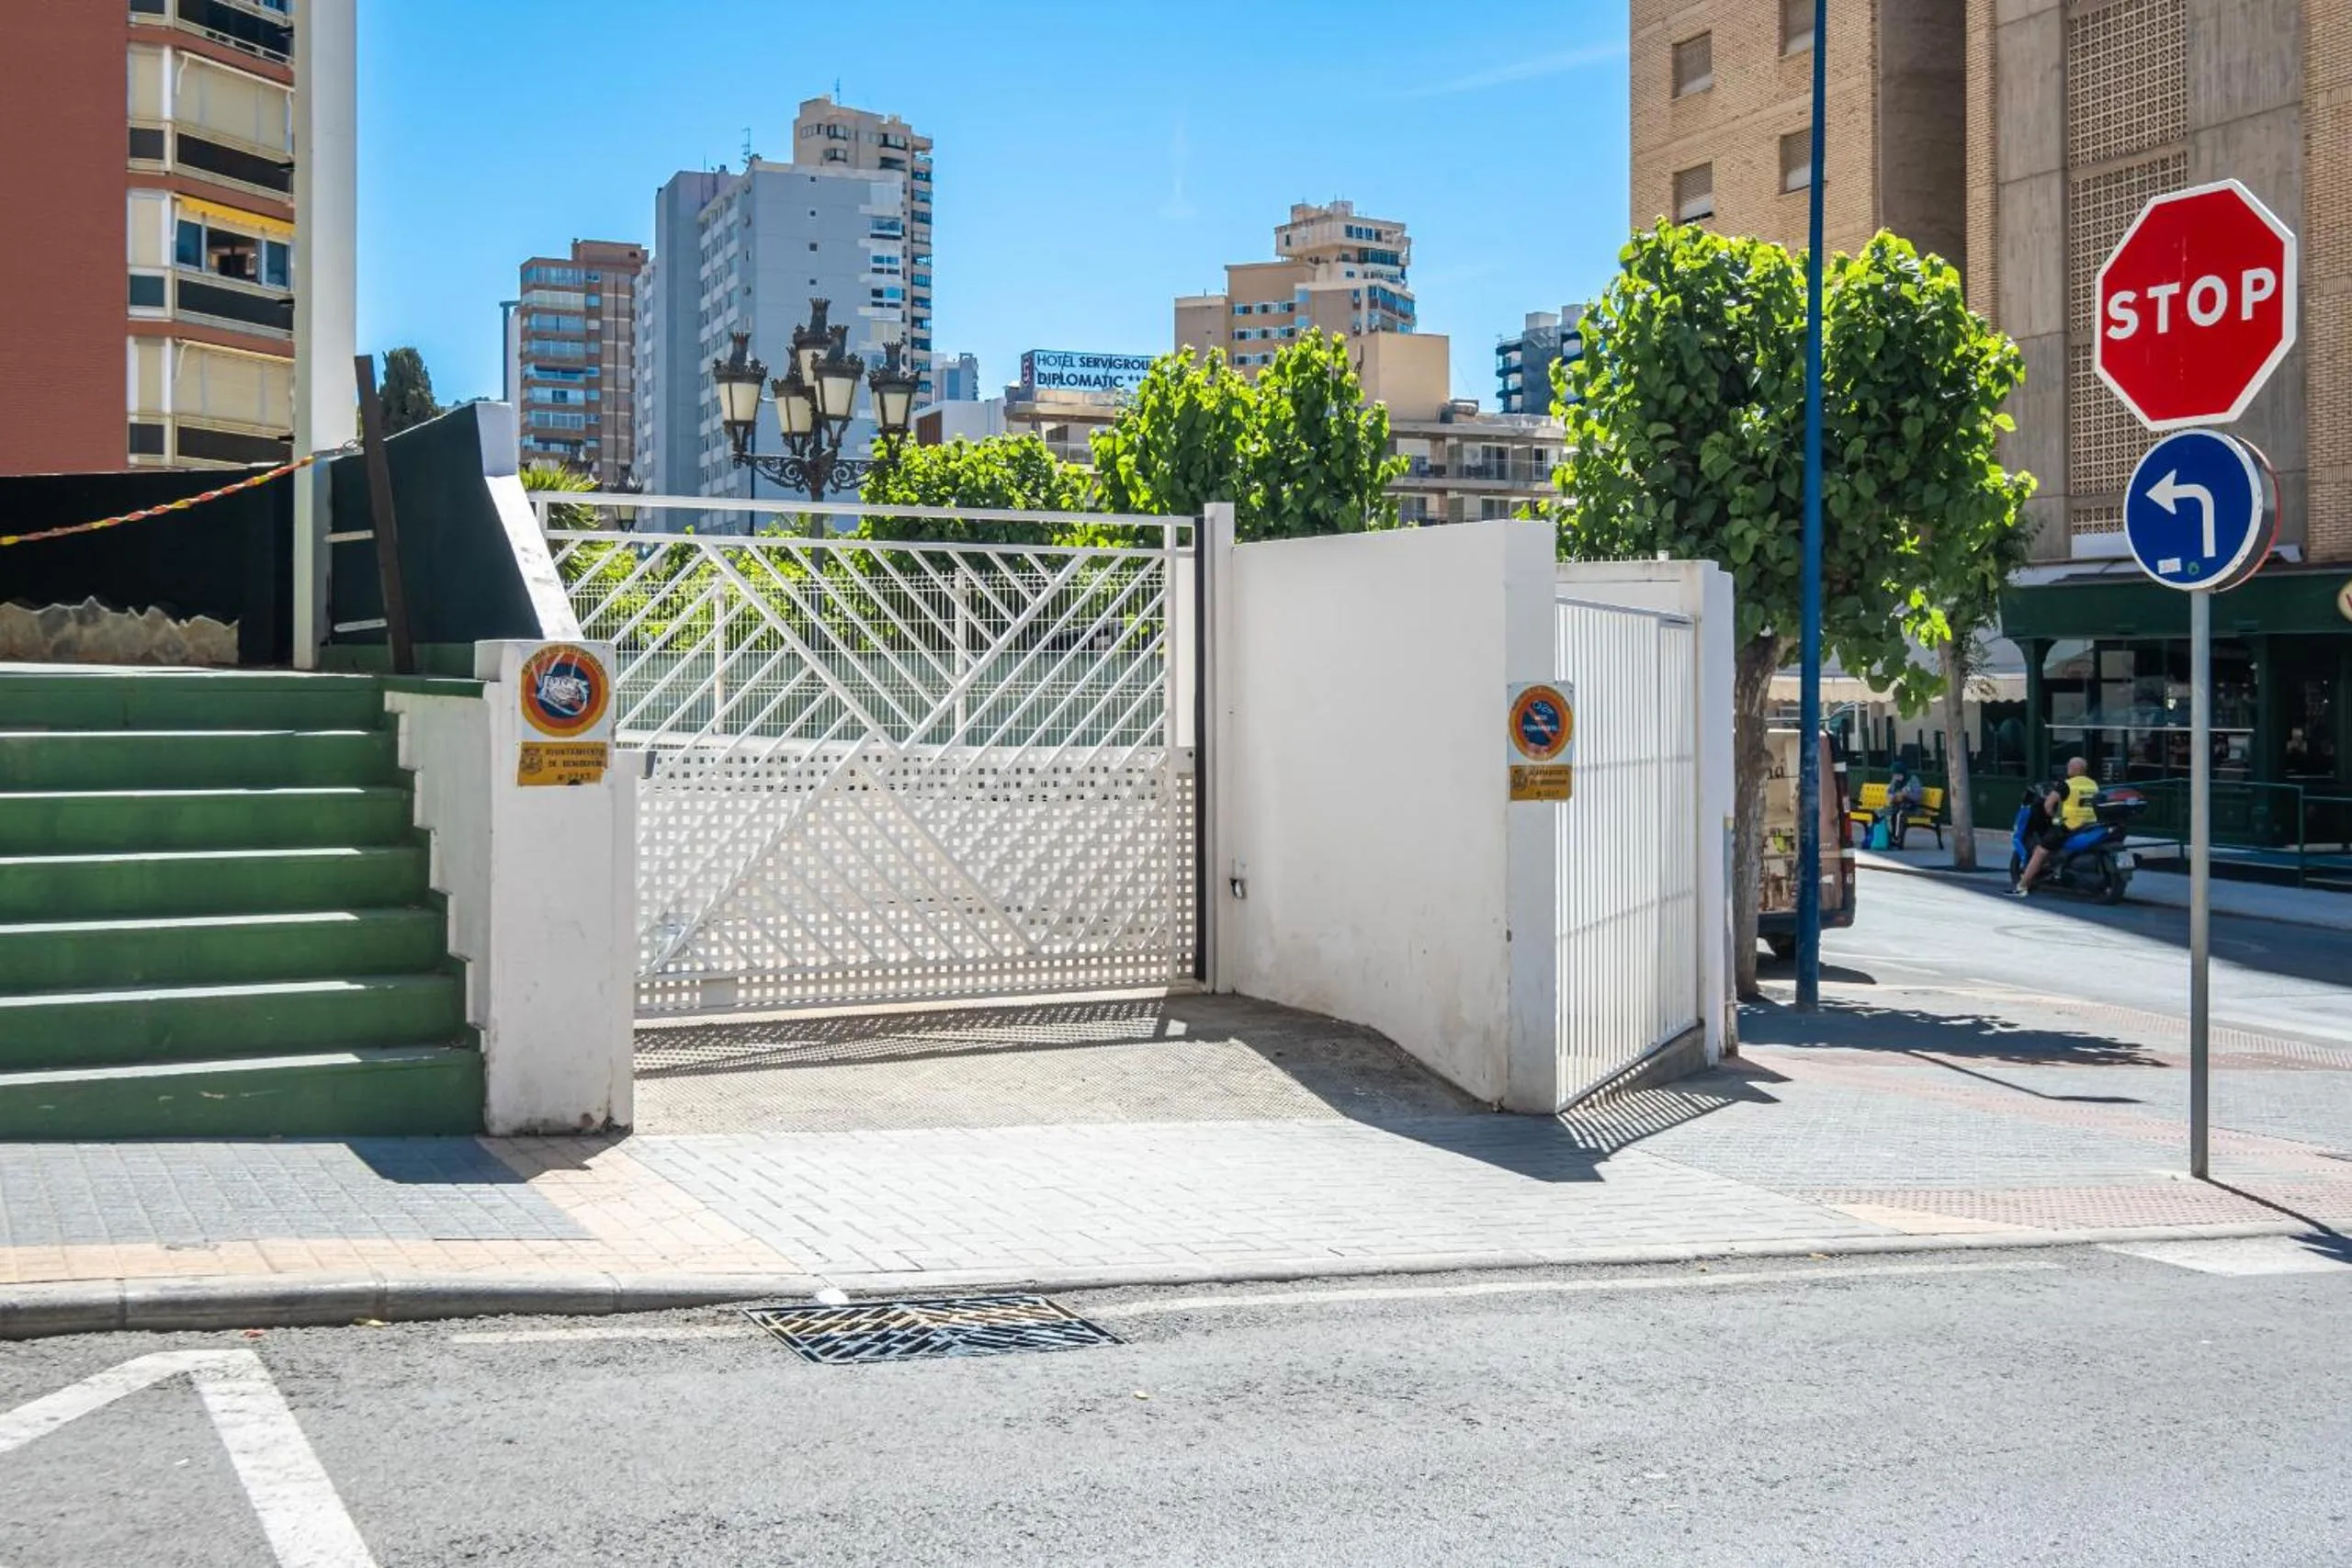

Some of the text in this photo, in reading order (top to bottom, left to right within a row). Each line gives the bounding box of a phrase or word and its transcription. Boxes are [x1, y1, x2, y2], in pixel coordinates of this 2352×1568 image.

[2106, 267, 2277, 340] STOP
[1037, 354, 1149, 371] HOTEL SERVIGROU
[1037, 373, 1125, 389] DIPLOMATIC
